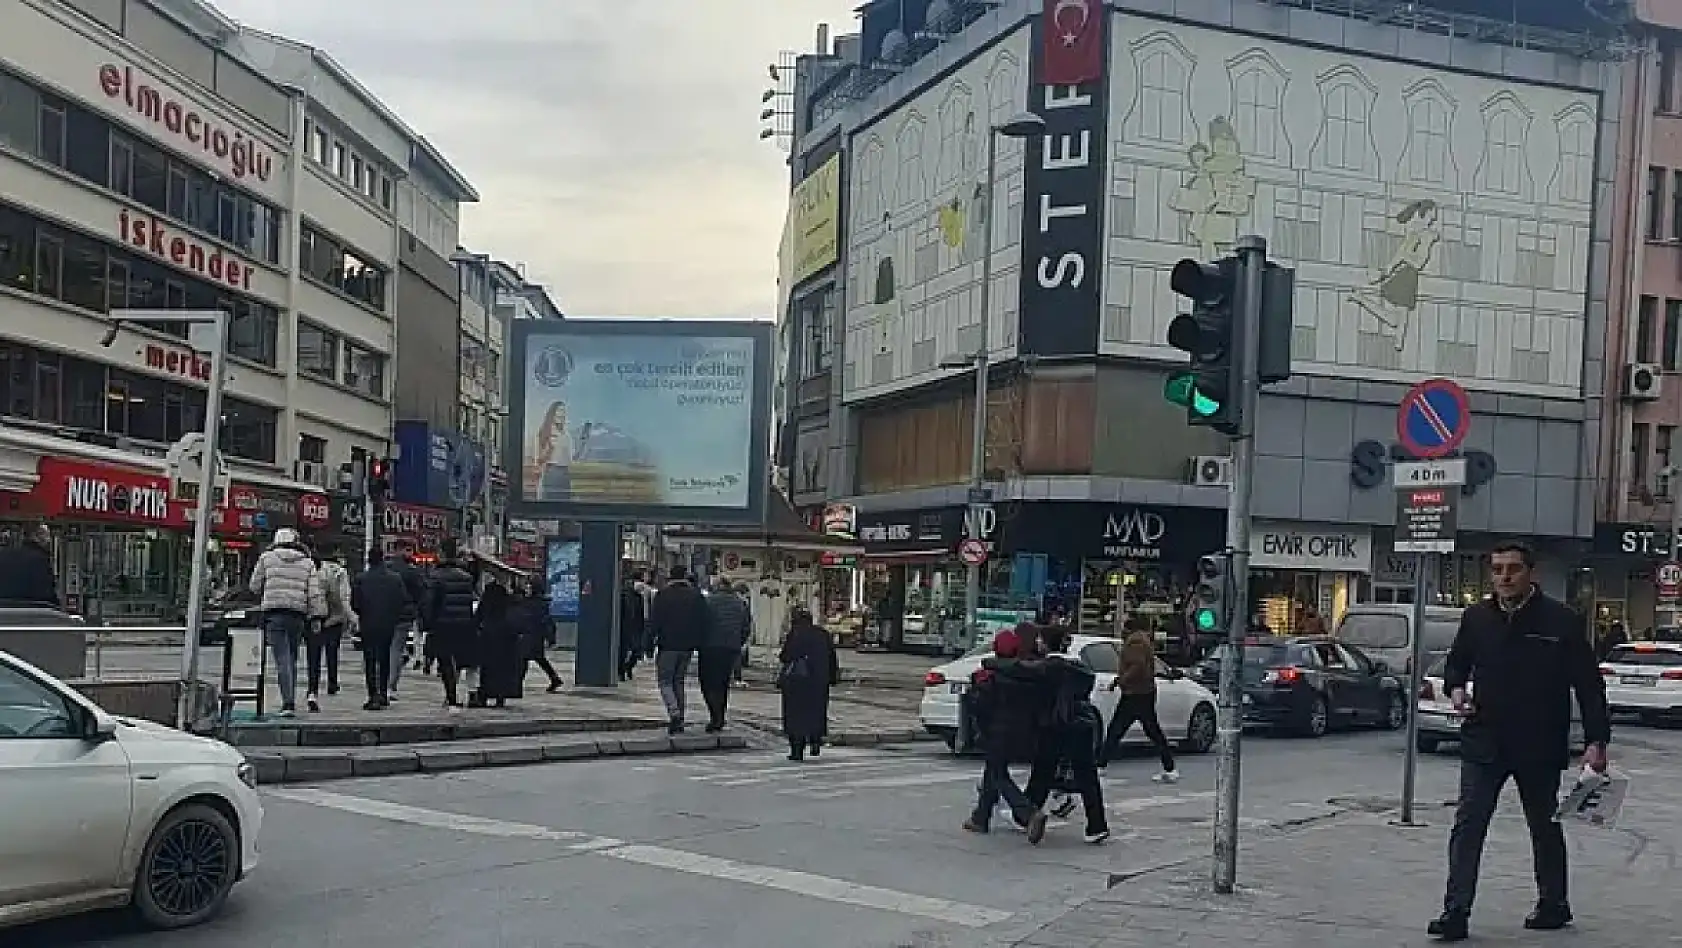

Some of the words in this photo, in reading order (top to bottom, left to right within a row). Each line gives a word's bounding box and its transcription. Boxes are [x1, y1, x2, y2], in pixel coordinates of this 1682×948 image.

[119, 209, 254, 291] iskender
[68, 476, 108, 512] NUR
[1308, 534, 1358, 559] OPTİK
